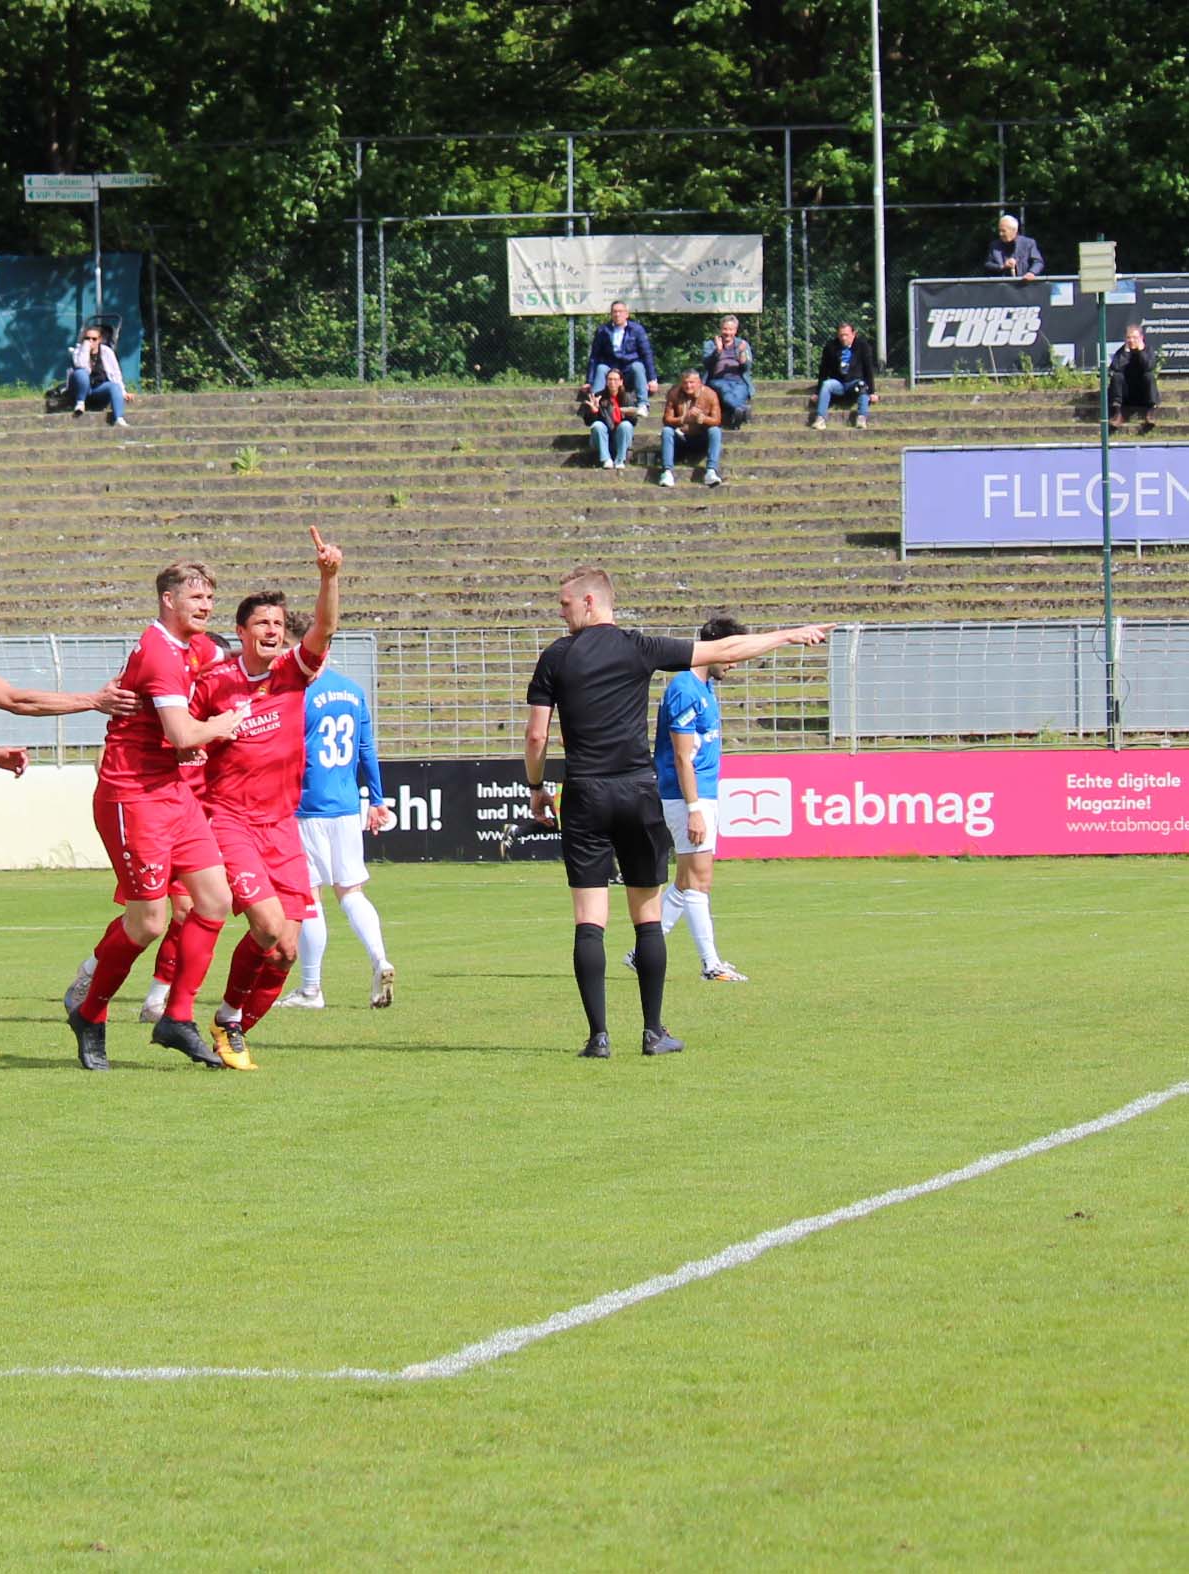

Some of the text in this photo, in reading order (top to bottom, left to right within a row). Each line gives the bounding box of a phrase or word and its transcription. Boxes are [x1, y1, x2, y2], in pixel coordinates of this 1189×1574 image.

[318, 713, 355, 768] 33
[1066, 772, 1181, 792] Echte digitale
[477, 803, 508, 820] und
[801, 781, 995, 837] tabmag
[1066, 795, 1152, 814] Magazine!
